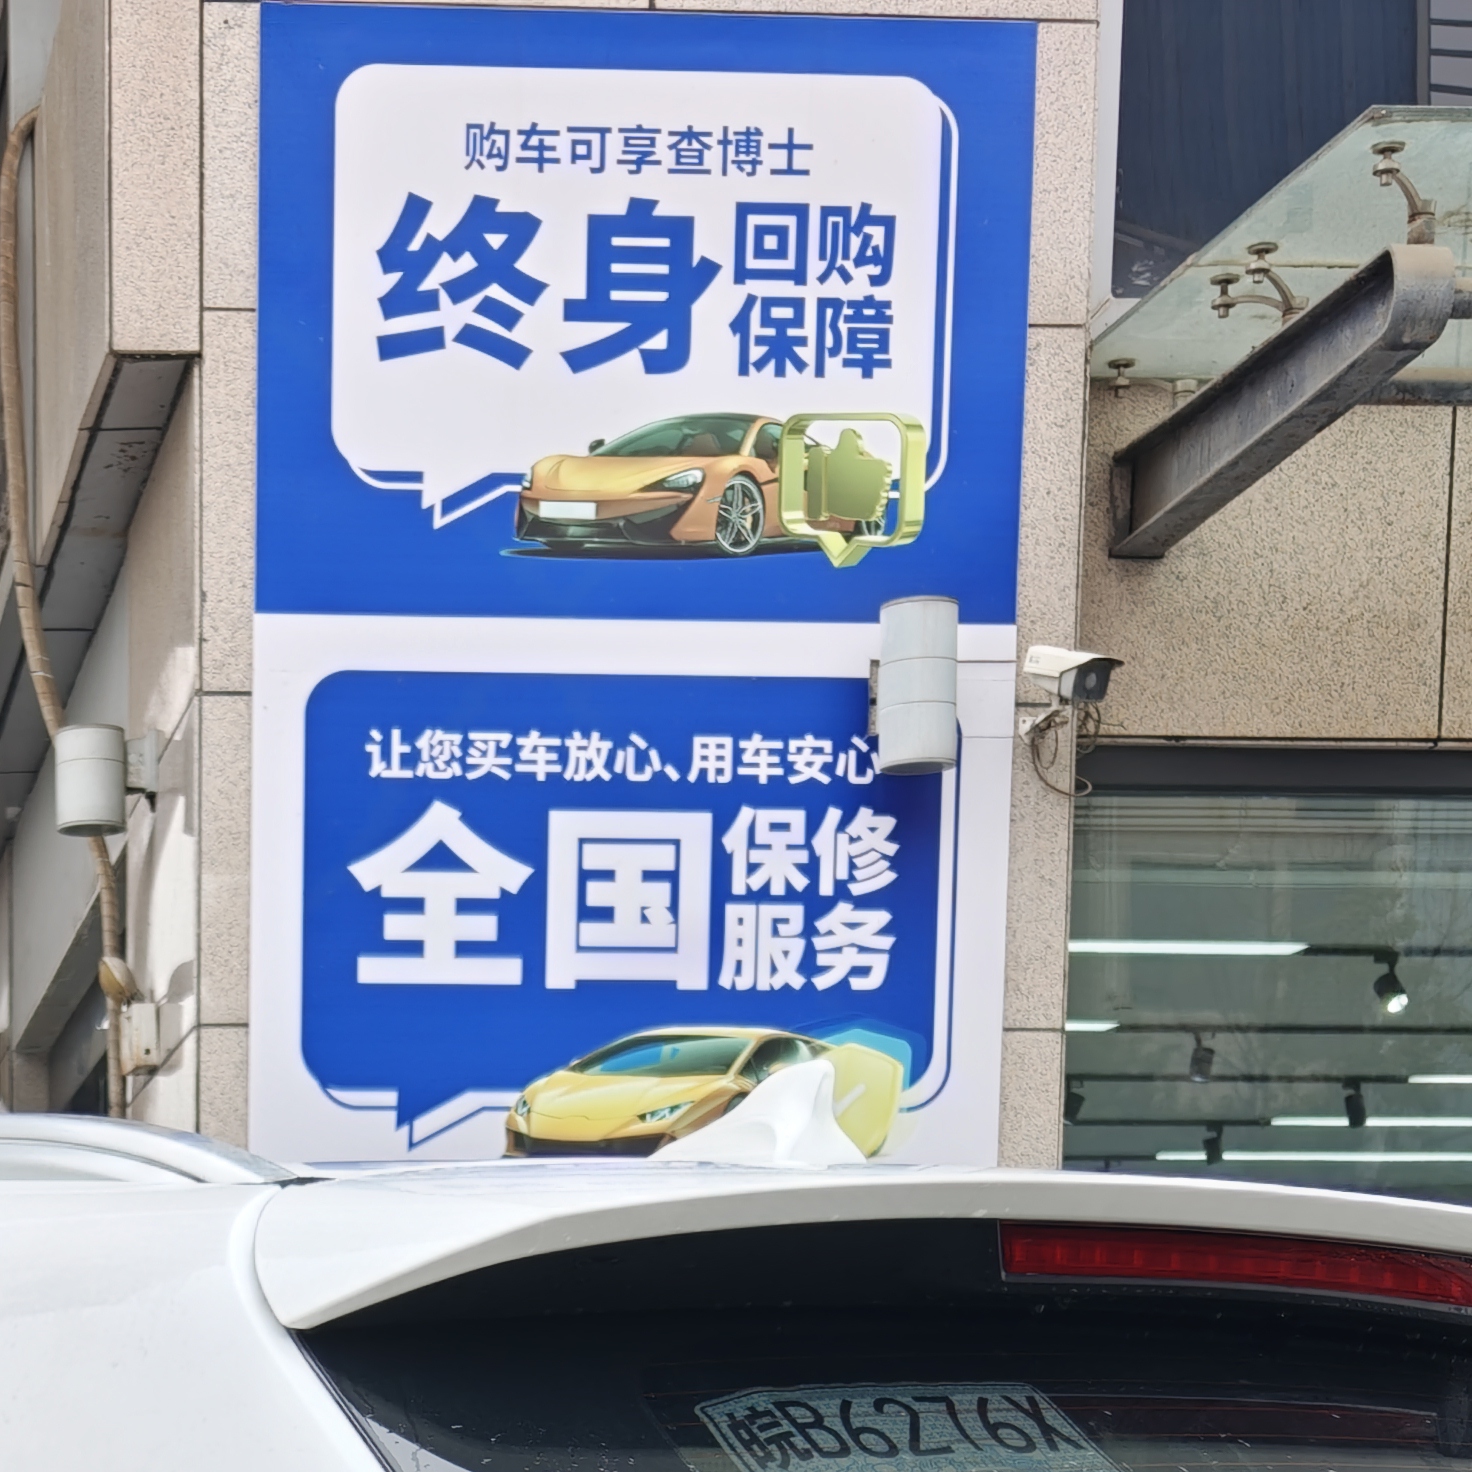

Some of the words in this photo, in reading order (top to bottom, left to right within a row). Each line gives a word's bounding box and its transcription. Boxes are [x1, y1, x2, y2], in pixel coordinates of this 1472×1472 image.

[464, 121, 814, 178] 购车可享查博士
[375, 191, 723, 375] 终身
[732, 202, 897, 288] 回购
[730, 294, 894, 380] 保障
[365, 728, 880, 786] 让您买车放心、用车安心
[722, 805, 901, 897] 保修
[347, 800, 713, 990] 全国
[718, 903, 897, 992] 服务
